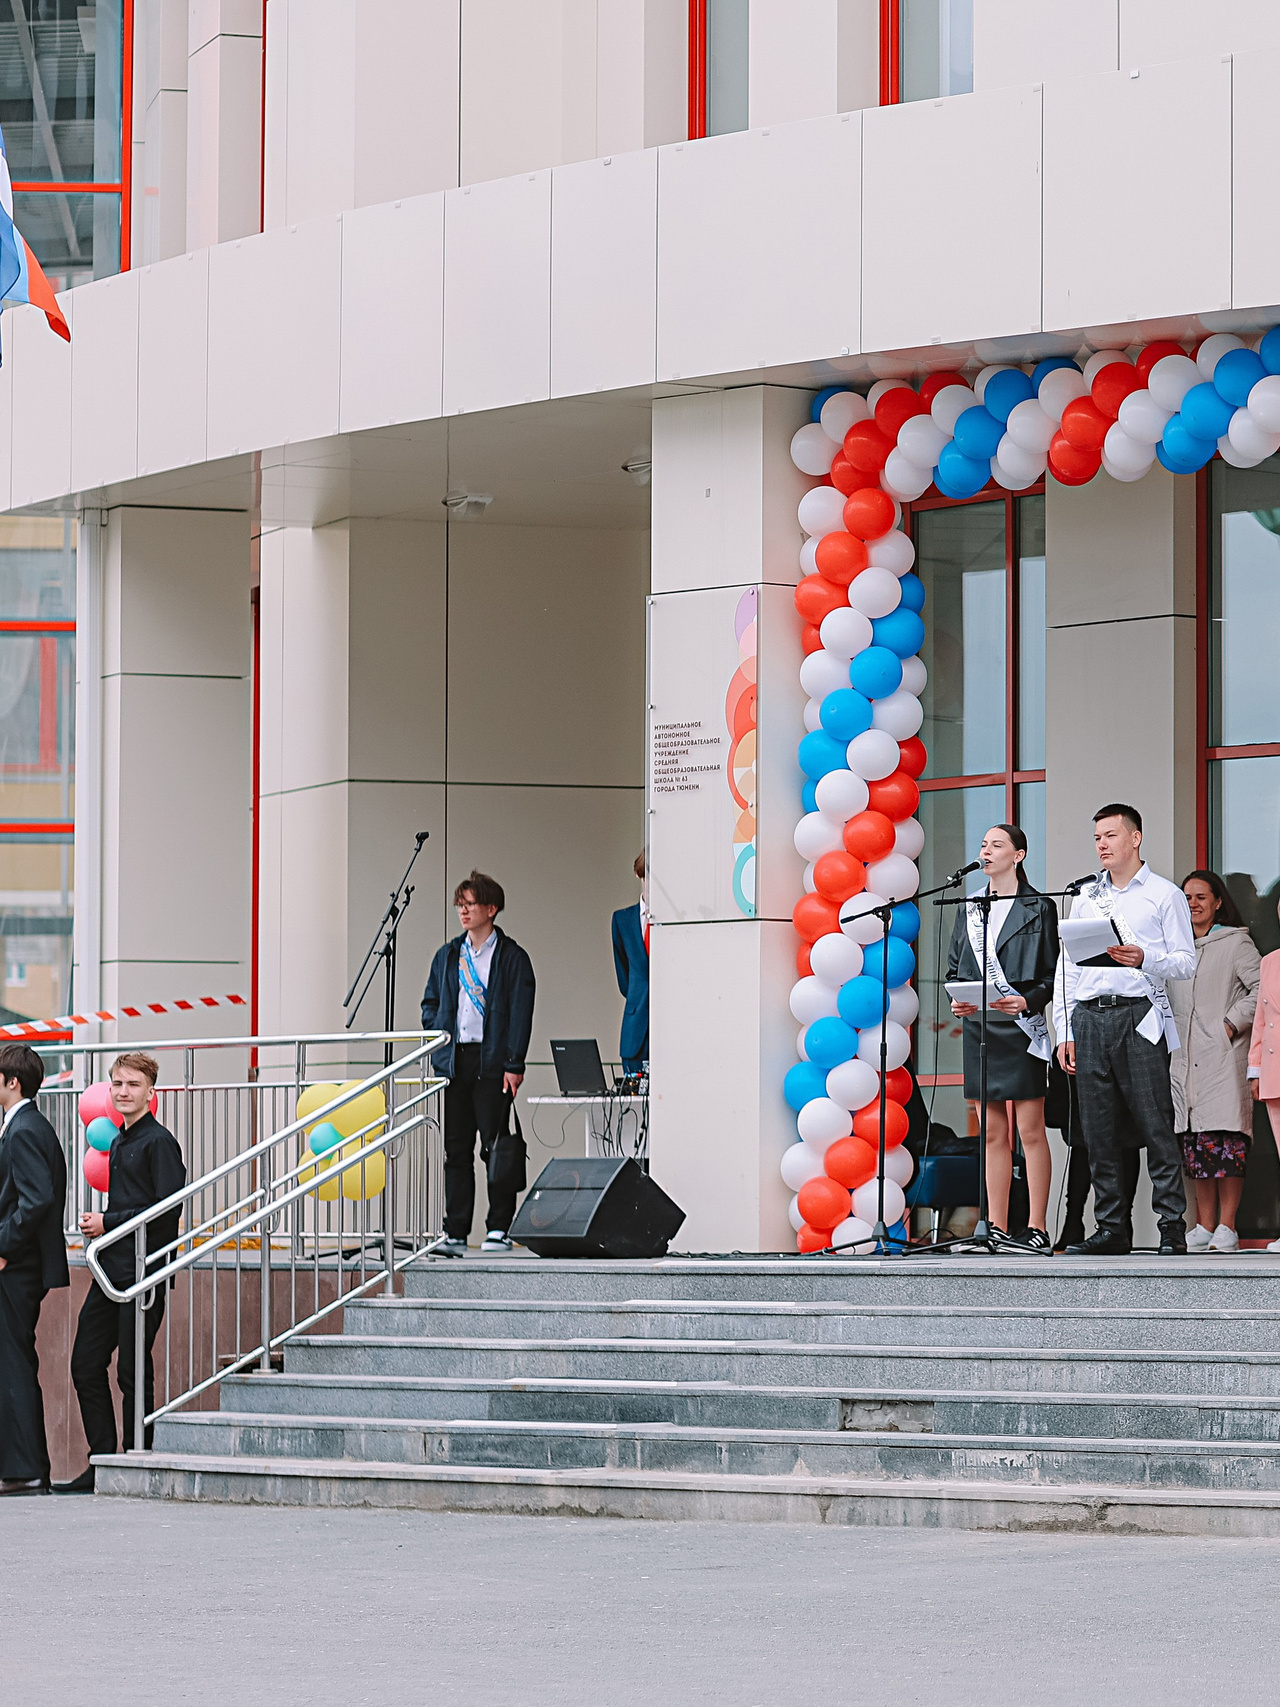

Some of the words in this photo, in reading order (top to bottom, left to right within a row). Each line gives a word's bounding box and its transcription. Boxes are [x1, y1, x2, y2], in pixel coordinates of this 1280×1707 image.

[654, 721, 701, 731] МУНИЦИПАЛЬНОЕ
[654, 731, 690, 739] АВТОНОМНОЕ
[654, 738, 720, 748] ОБЩЕОБРАЗОВАТЕЛЬНОЕ
[654, 749, 688, 757] УЧРЕЖДЕНИЕ
[654, 758, 678, 766] СРЕДНЯЯ
[654, 764, 720, 775] ОБЩЕОБРАЗОВАТЕЛЬНАЯ
[654, 785, 675, 793] ГОРОДА
